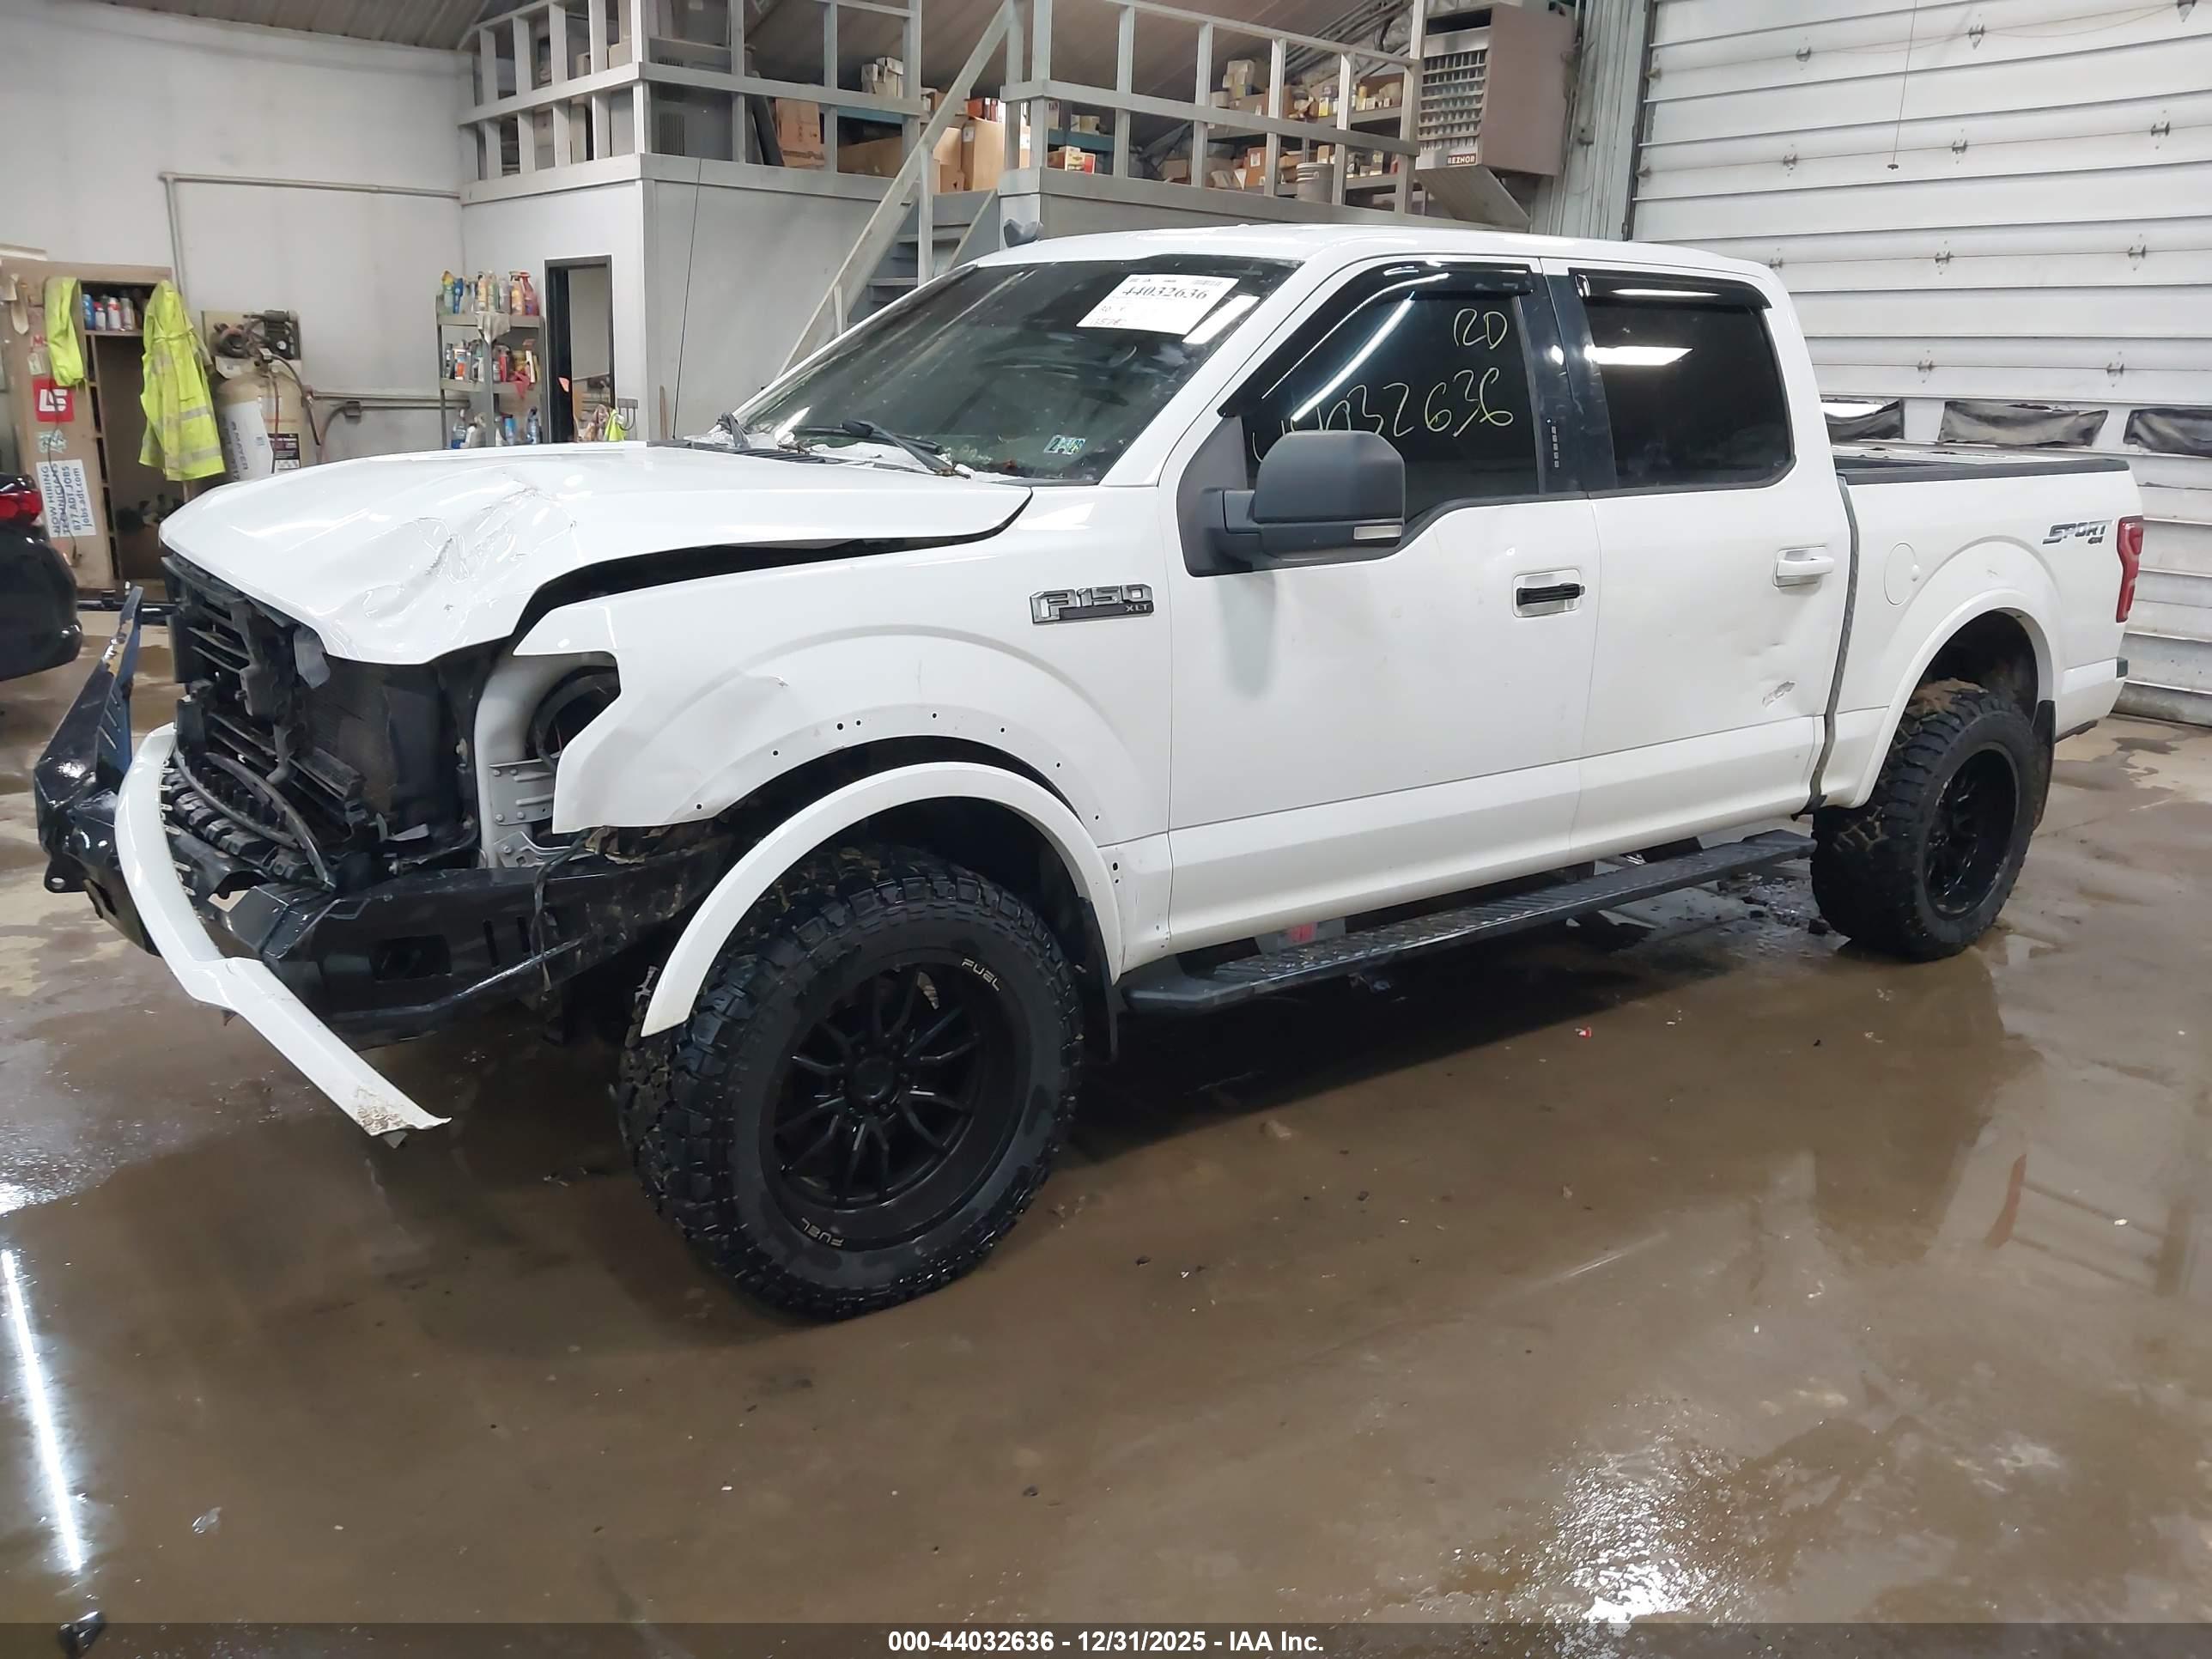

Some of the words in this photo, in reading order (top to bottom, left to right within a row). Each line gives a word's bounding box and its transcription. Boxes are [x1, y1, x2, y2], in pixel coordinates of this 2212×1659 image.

[1447, 155, 1475, 164] REZNOR
[1121, 286, 1209, 300] 44032636
[40, 465, 56, 505] HIRING
[47, 507, 60, 535] NOW
[2042, 520, 2113, 544] SPORT
[1126, 603, 1148, 612] XLT
[962, 957, 1000, 991] FUEL
[802, 1217, 844, 1246] FUEL
